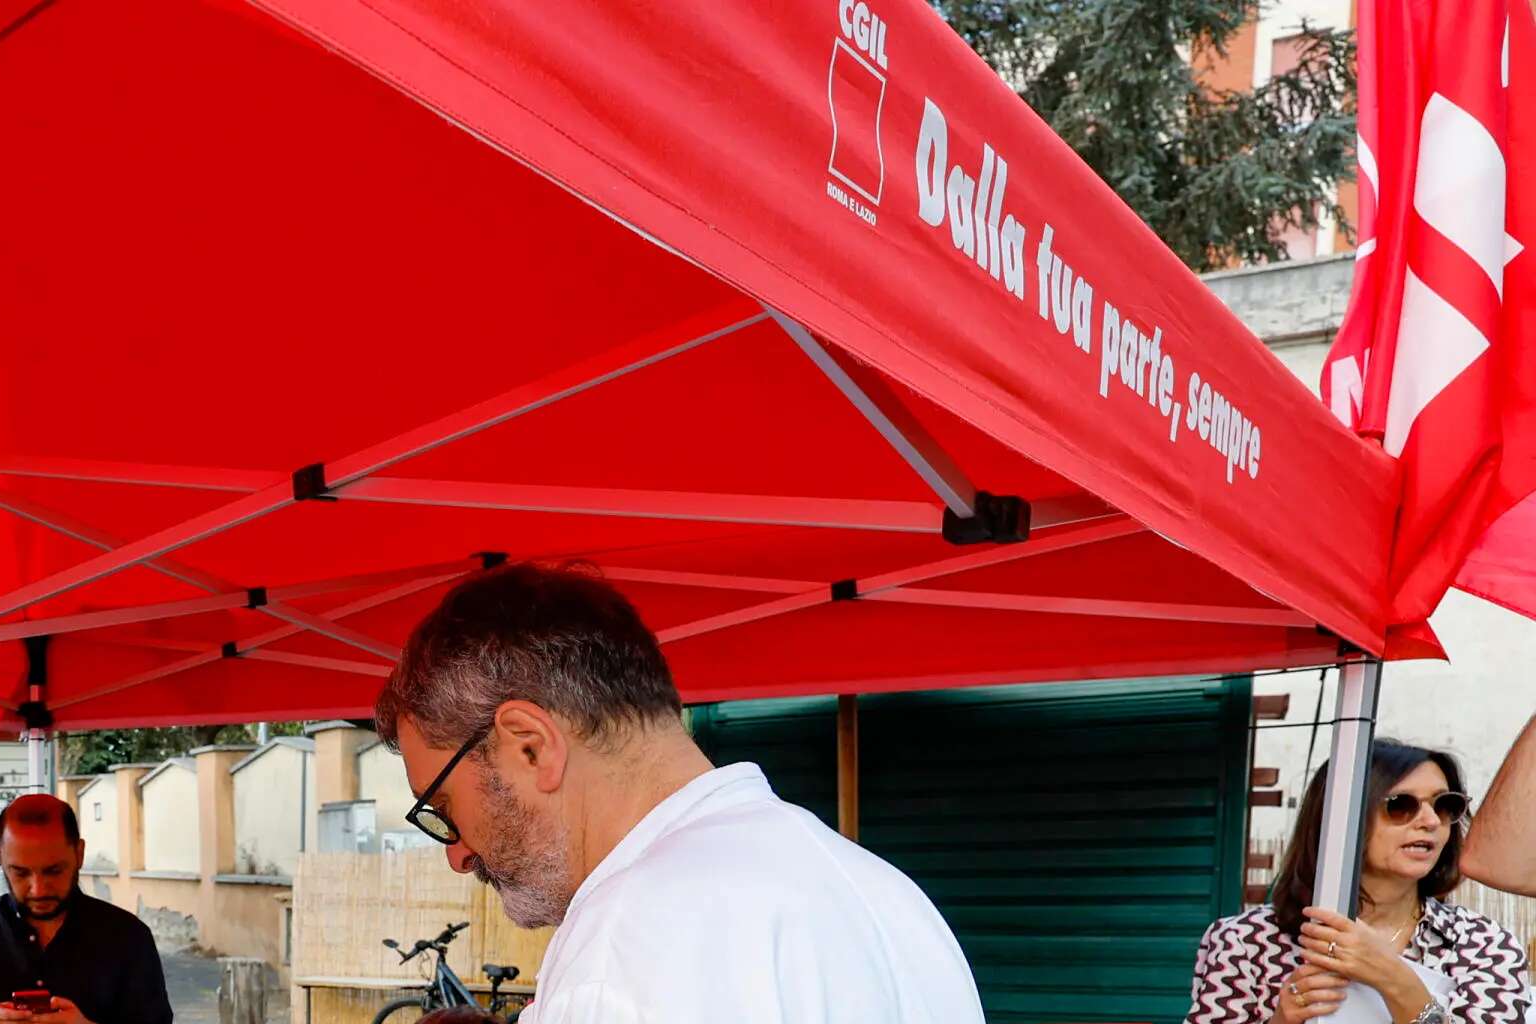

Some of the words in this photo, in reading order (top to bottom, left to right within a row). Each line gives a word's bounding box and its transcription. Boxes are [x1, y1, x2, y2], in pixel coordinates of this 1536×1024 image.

[838, 0, 888, 71] CGIL
[826, 182, 849, 210] ROMA
[849, 199, 856, 213] E
[855, 203, 877, 227] LAZIO
[915, 95, 1026, 301] Dalla
[1036, 222, 1095, 353] tua
[1099, 299, 1182, 443] parte,
[1185, 371, 1261, 485] sempre
